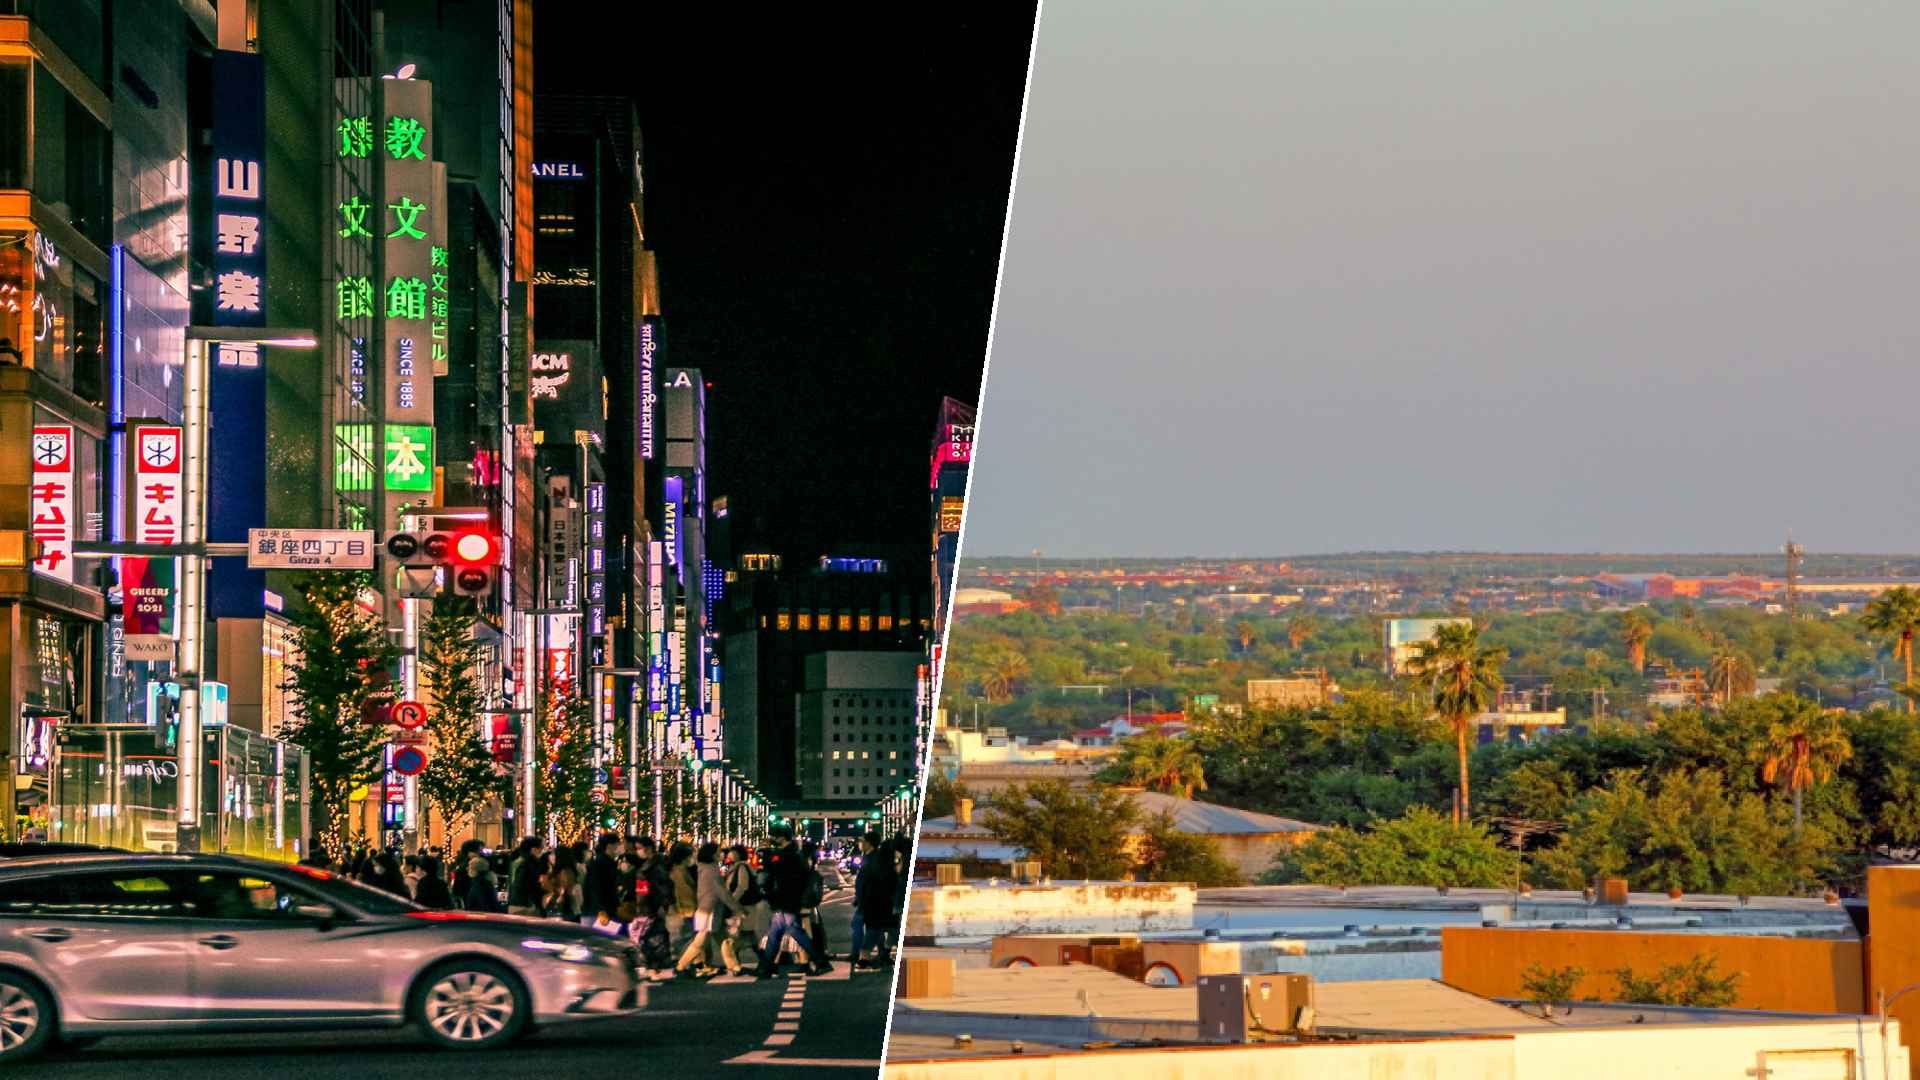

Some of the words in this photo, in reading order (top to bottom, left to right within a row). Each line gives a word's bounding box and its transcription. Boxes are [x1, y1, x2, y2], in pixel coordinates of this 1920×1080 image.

[384, 116, 427, 320] 教文館
[432, 246, 448, 361] 教文館ビル
[401, 338, 413, 376] SINCE
[401, 381, 413, 408] 1885
[387, 436, 426, 480] 本
[258, 530, 291, 538] 中央区
[258, 539, 365, 555] 銀座四丁目
[289, 556, 320, 564] Ginza
[324, 556, 333, 564] 4
[130, 587, 168, 596] CHEERS
[137, 604, 163, 612] 2021
[134, 643, 168, 651] WAKO
